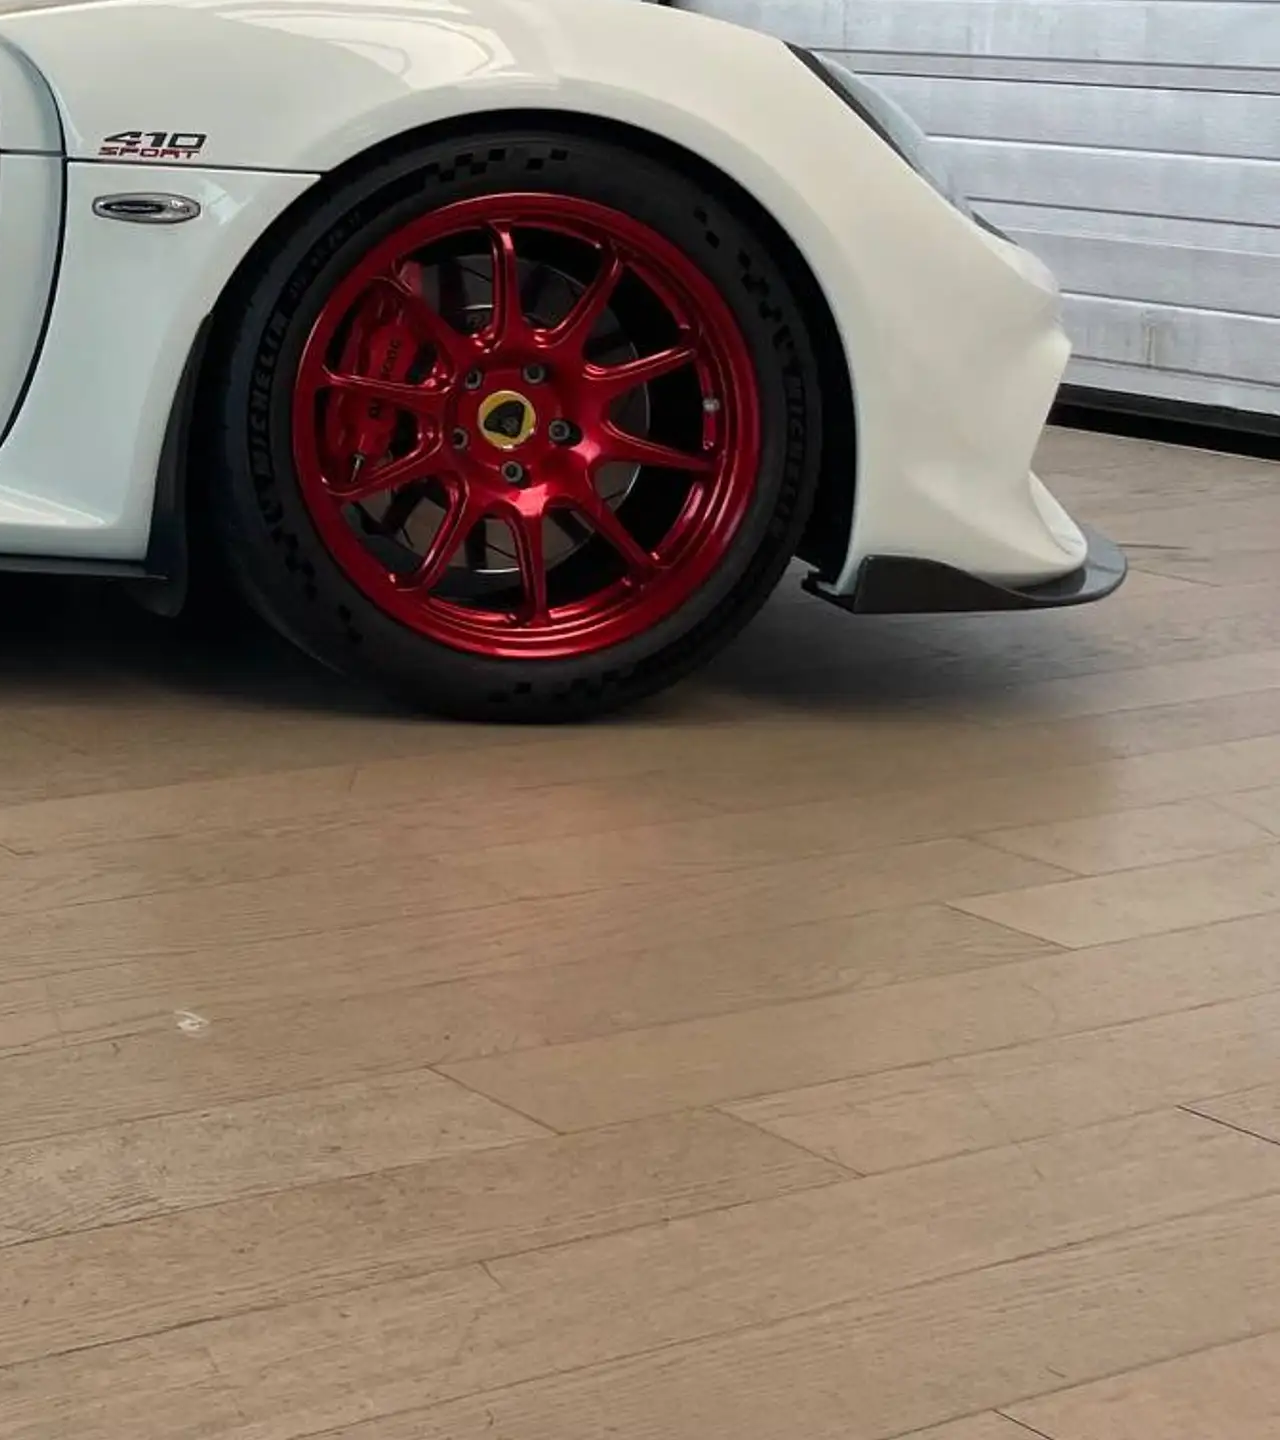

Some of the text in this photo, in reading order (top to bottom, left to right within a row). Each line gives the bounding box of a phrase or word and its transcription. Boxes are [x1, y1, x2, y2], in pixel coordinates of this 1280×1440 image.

[104, 131, 207, 149] 410
[98, 146, 200, 159] SPORT
[248, 309, 289, 474] MICHELIN
